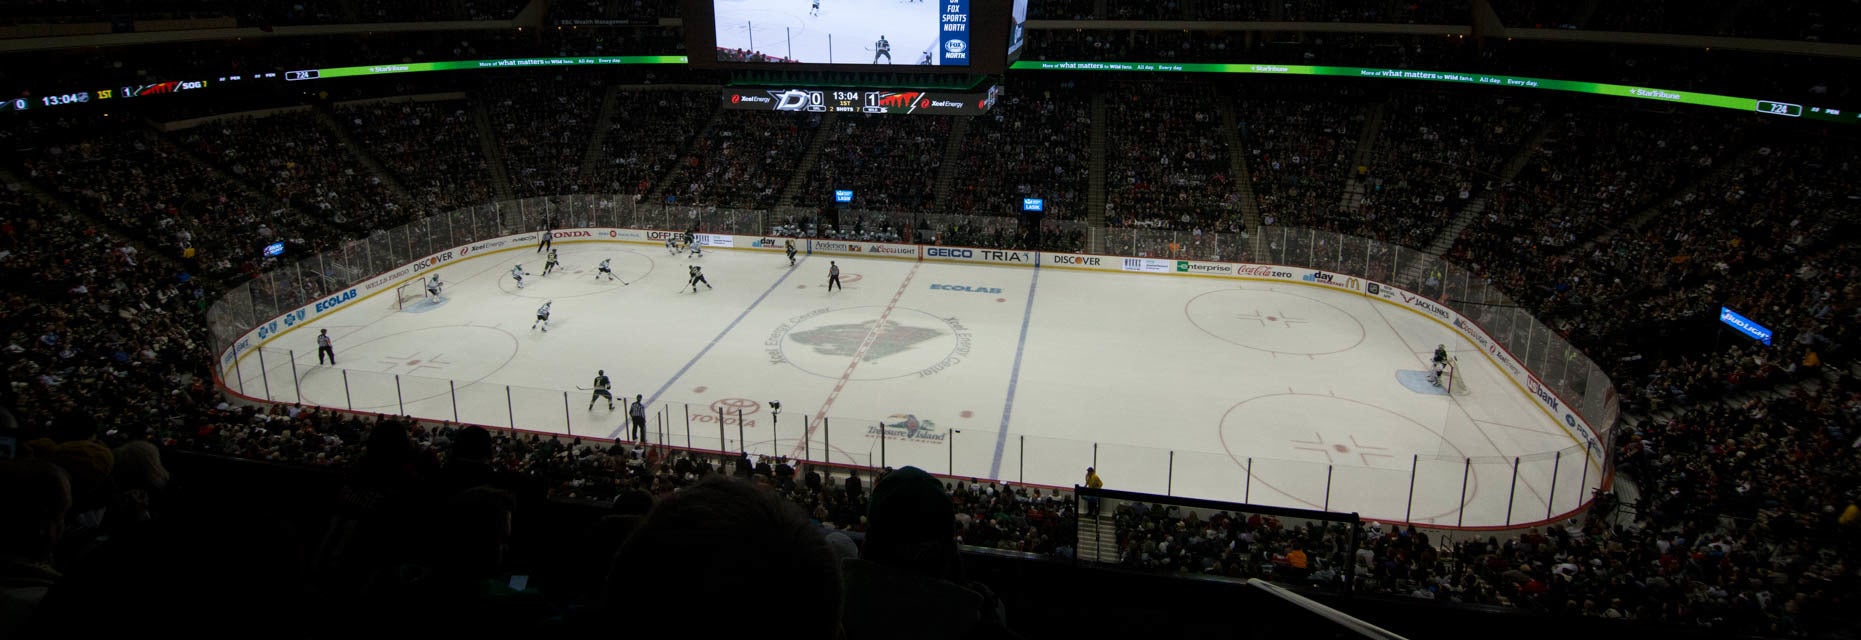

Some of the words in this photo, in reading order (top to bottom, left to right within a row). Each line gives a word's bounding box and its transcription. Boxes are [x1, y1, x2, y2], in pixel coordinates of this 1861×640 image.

[947, 5, 960, 13] FOX
[942, 14, 967, 22] SPORTS
[944, 24, 965, 32] NORTH
[1404, 71, 1436, 80] matters
[182, 81, 201, 90] SOG
[97, 90, 112, 99] 1ST
[812, 93, 821, 105] 0
[833, 91, 858, 100] 13:04
[1637, 88, 1681, 100] StarTribune
[16, 100, 25, 109] 0
[42, 94, 78, 106] 13:04
[869, 94, 876, 106] 1
[1770, 103, 1788, 114] 724
[761, 237, 776, 246] day
[927, 247, 973, 258] GEICO
[980, 250, 1022, 262] TRIA
[413, 251, 453, 273] DISCOVER
[1053, 255, 1101, 266] DISCOVER
[1271, 270, 1292, 279] zero
[1314, 271, 1334, 282] day
[315, 289, 358, 313] ECOLAB
[1431, 305, 1449, 319] LINKS
[1743, 323, 1770, 341] LIGHT
[1537, 383, 1560, 411] bank
[915, 430, 946, 441] Island
